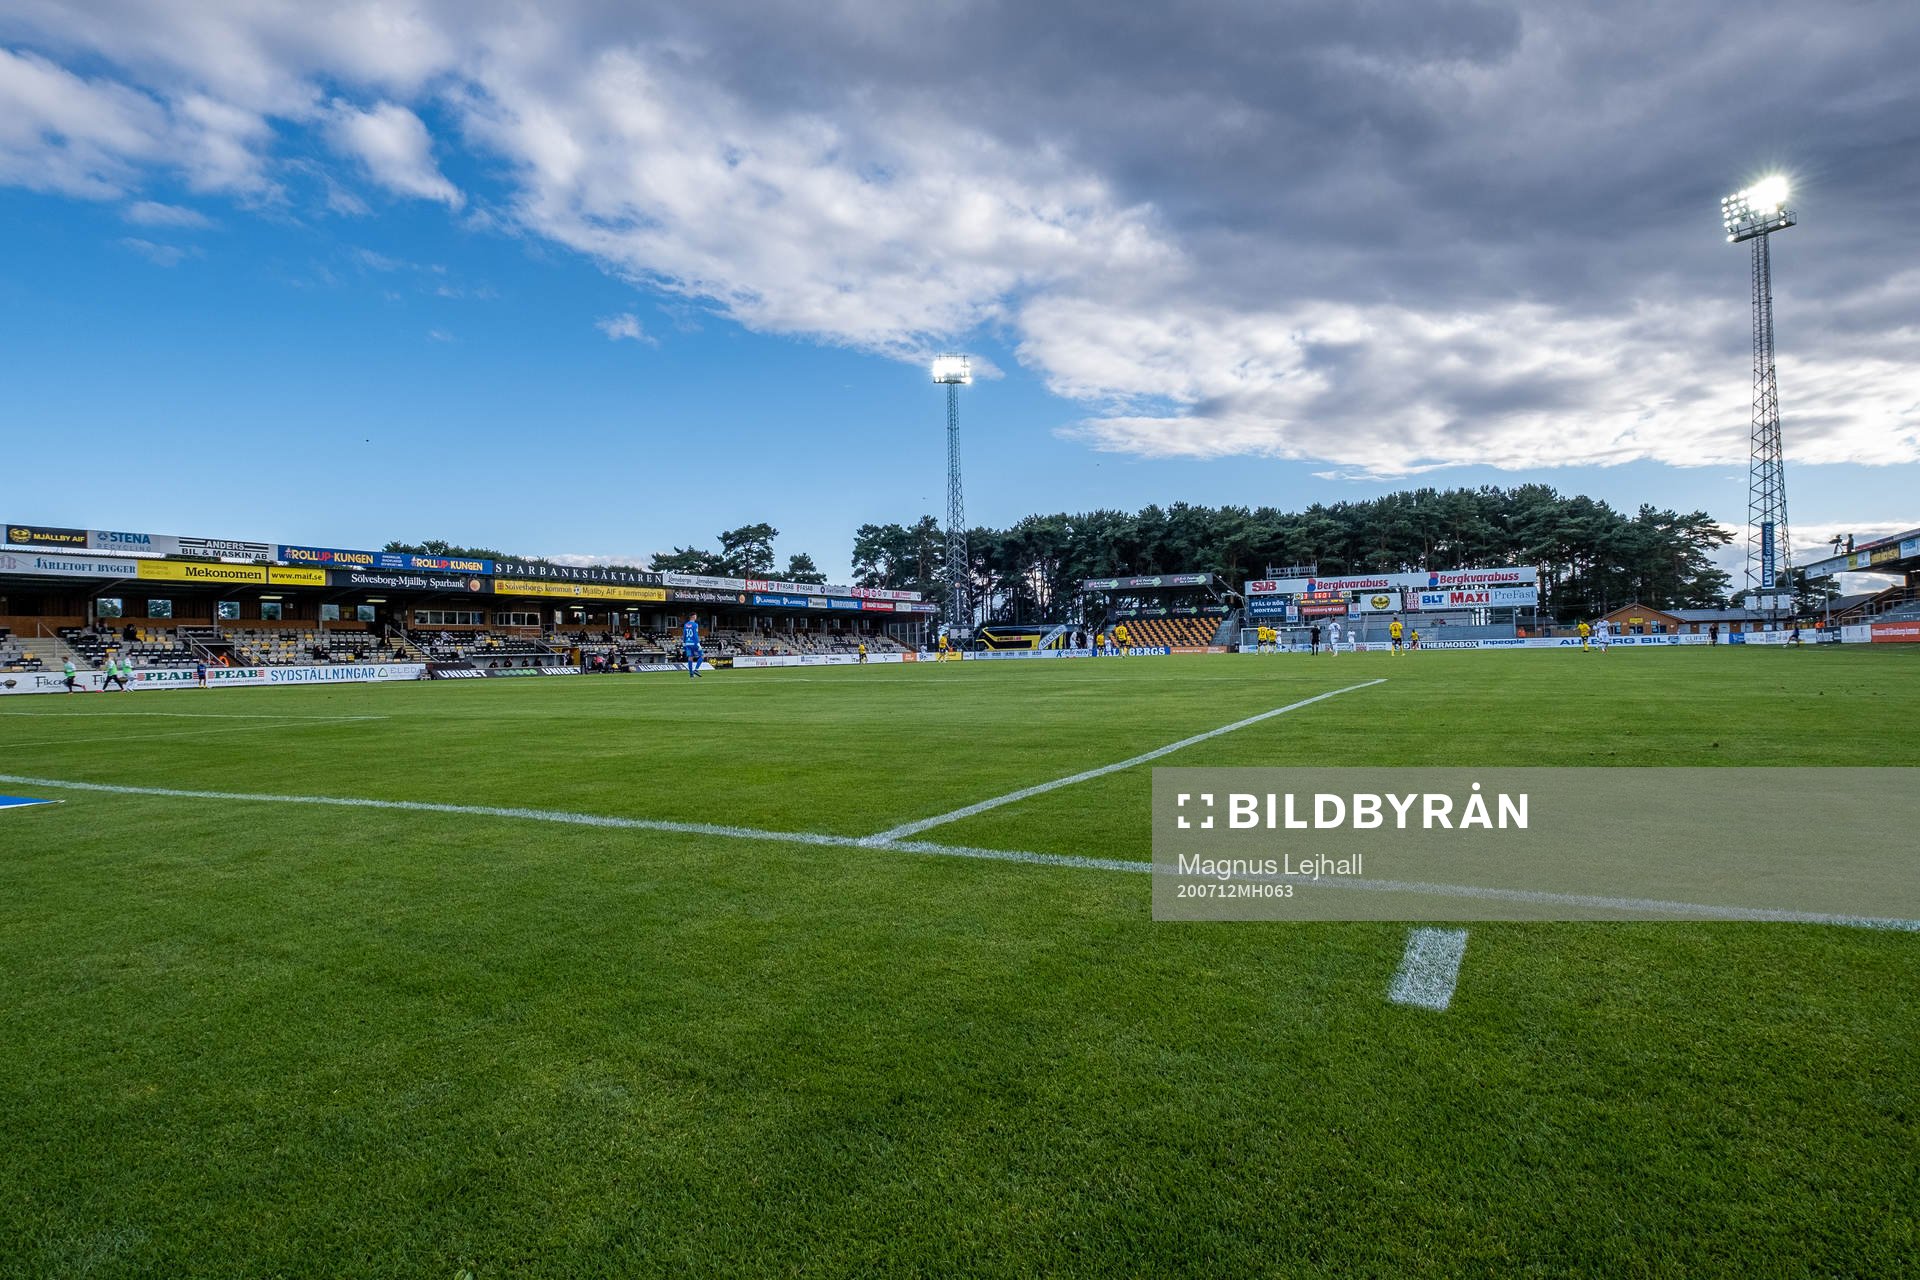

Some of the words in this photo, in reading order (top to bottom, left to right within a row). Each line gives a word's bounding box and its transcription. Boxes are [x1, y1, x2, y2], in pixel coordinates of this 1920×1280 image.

[110, 532, 151, 544] STENA
[206, 540, 245, 550] ANDERS
[212, 550, 252, 558] MASKIN
[185, 566, 262, 580] Mekonomen
[271, 573, 322, 581] www.maif.se
[495, 563, 662, 583] SPARBANKSLÄKTAREN
[1440, 571, 1520, 585] Bergkvarabuss
[429, 578, 464, 589] Sparbank
[747, 582, 767, 590] SAVE
[1317, 579, 1389, 591] Bergkvarabuss
[1422, 595, 1444, 603] BLT
[1450, 592, 1489, 603] MAXI
[1494, 590, 1535, 599] PreFast
[1641, 636, 1666, 644] BIL
[1422, 641, 1478, 649] THERMOBOX
[215, 669, 258, 678] PEAB
[271, 667, 375, 682] SYDSTÄLLNINGAR
[437, 669, 487, 678] UNIBET
[541, 667, 581, 675] UNIBET
[145, 671, 193, 681] PEAB
